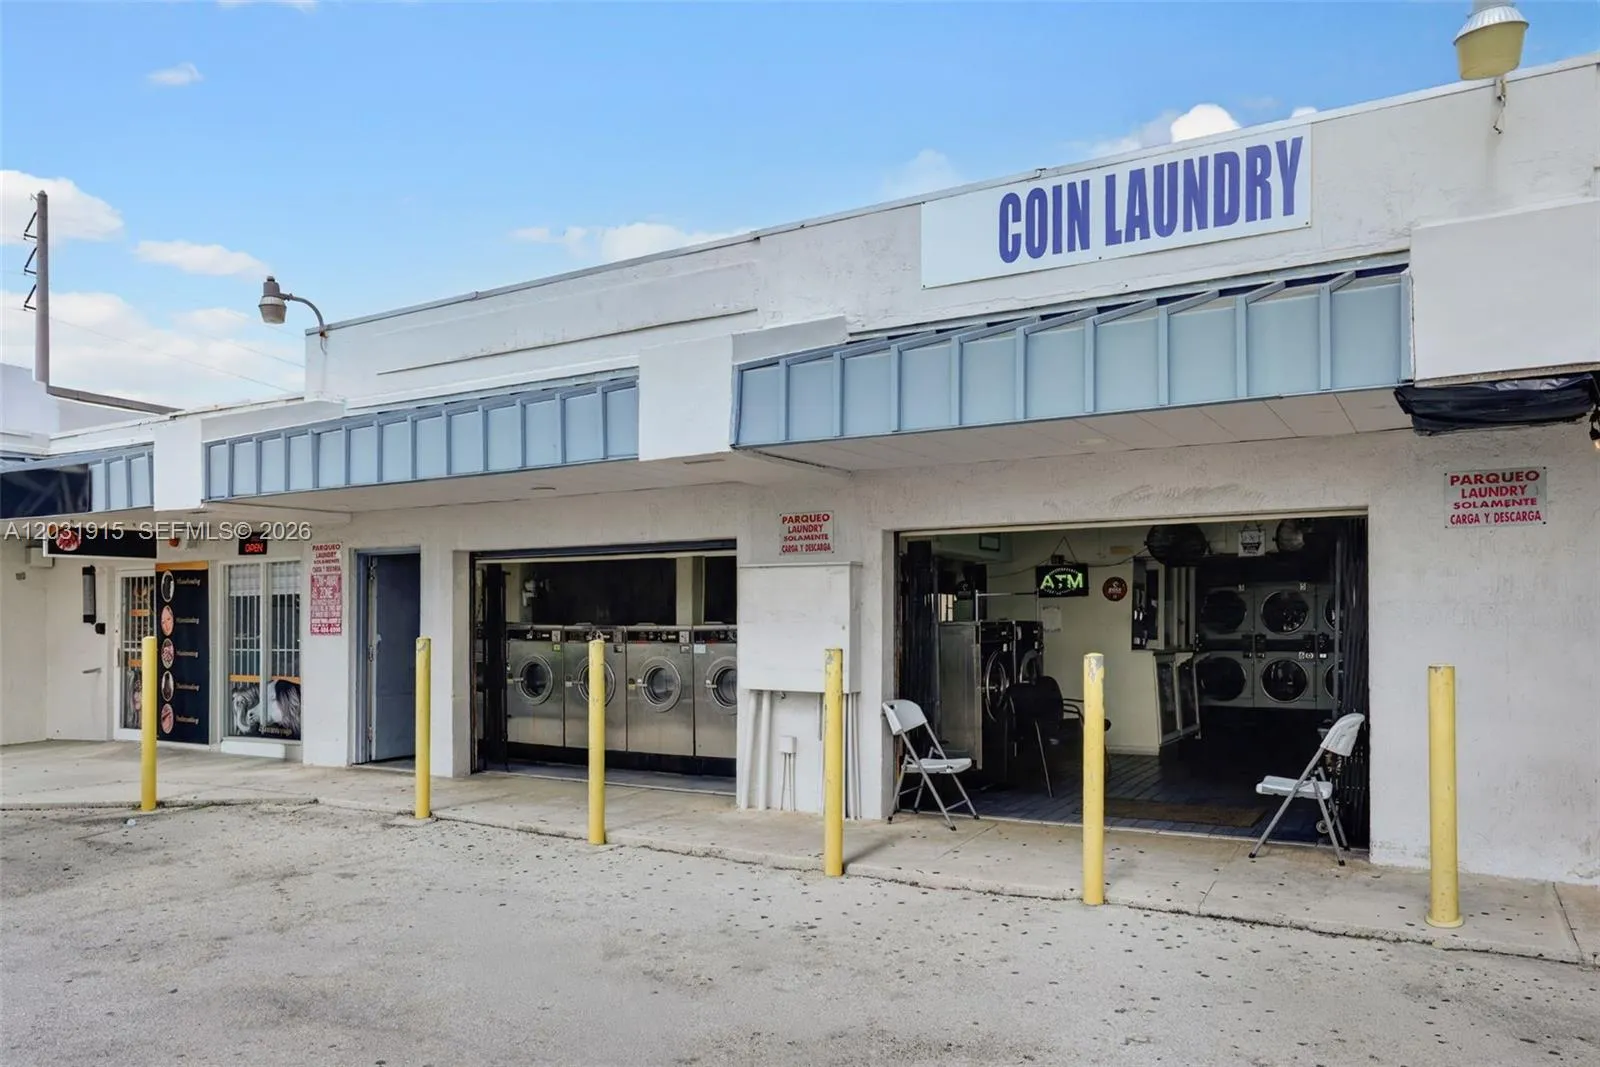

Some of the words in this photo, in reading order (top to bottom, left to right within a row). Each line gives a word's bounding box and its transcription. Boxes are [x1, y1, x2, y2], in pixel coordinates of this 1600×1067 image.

[999, 179, 1090, 264] COIN
[1105, 135, 1303, 246] LAUNDRY
[1450, 470, 1540, 486] PARQUEO
[1461, 485, 1528, 499] LAUNDRY
[1453, 498, 1537, 510] SOLAMENTE
[782, 513, 830, 524] PARQUEO
[1450, 513, 1480, 525] CARGA
[1484, 513, 1491, 523] Y
[1494, 510, 1541, 523] DESCARGA
[788, 524, 823, 534] LAUNDRY
[784, 534, 829, 542] SOLAMENTE
[245, 544, 264, 553] OPEN
[312, 543, 341, 551] PARQUEO
[782, 545, 798, 553] CARGA
[800, 544, 804, 552] Y
[805, 543, 831, 552] DESCARGA
[1039, 572, 1084, 590] ATM
